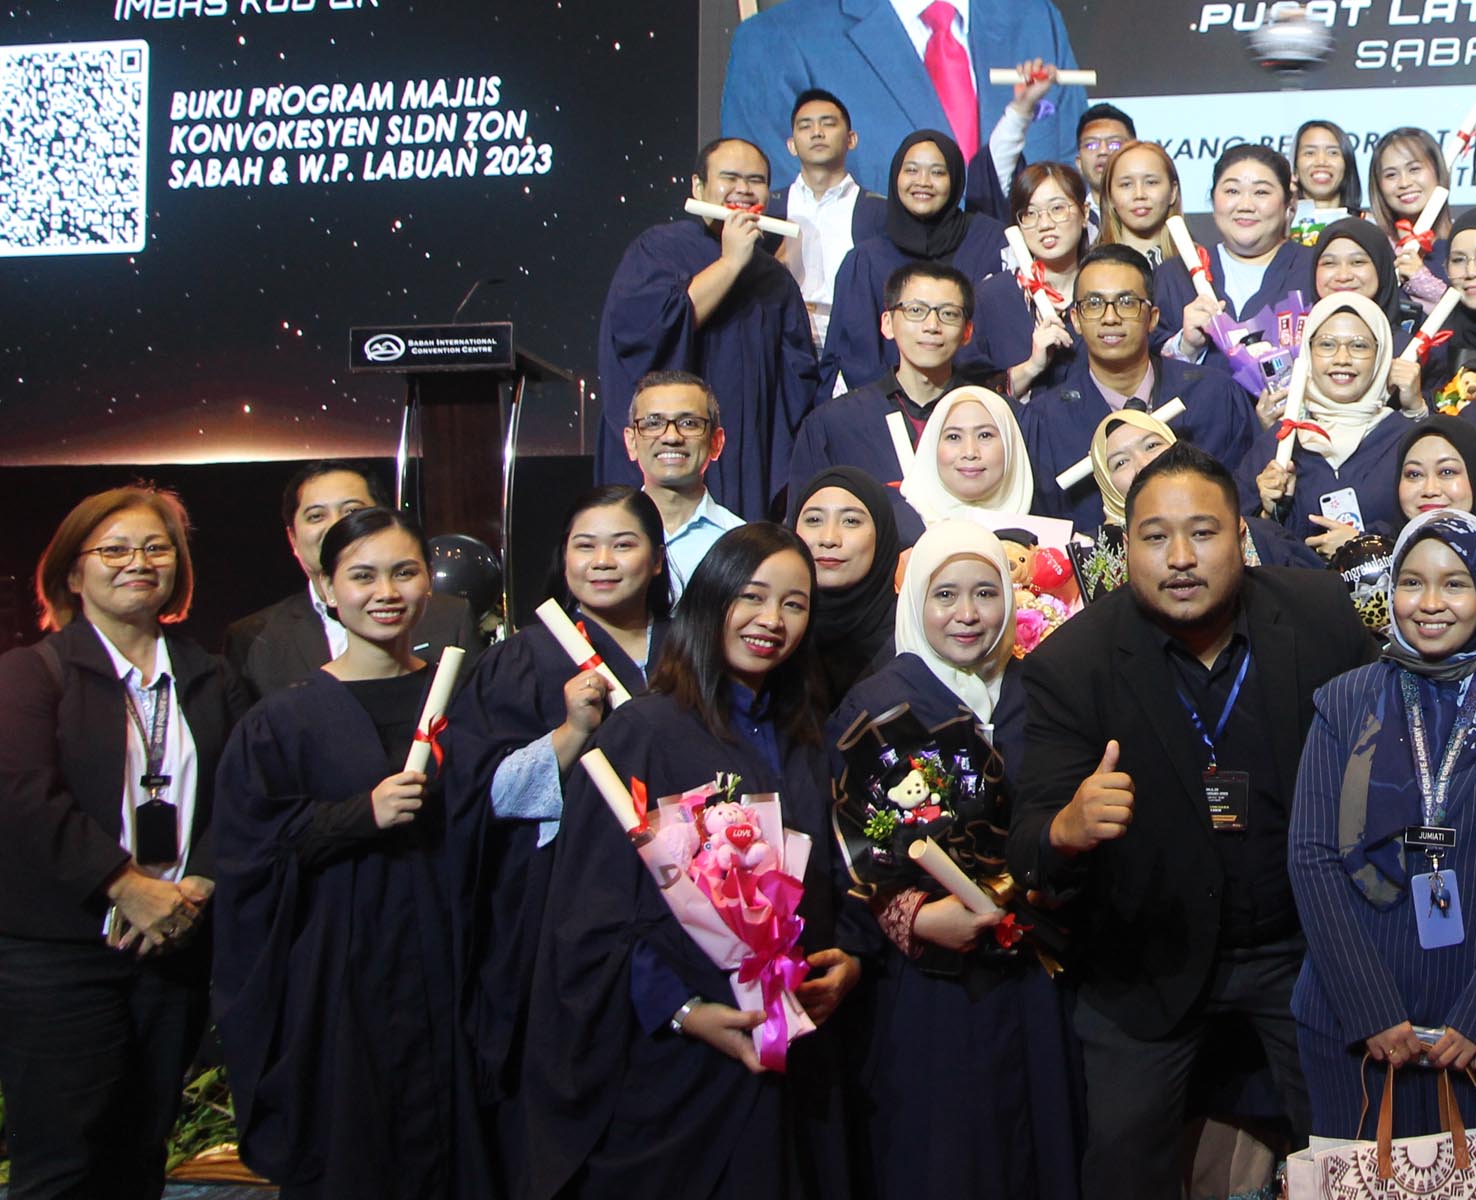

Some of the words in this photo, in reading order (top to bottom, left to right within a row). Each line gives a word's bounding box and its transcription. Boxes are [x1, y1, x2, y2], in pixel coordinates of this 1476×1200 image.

[114, 0, 228, 21] IMBAS
[170, 88, 243, 120] BUKU
[248, 81, 394, 117] PROGRAM
[400, 76, 502, 110] MAJLIS
[169, 115, 380, 154] KONVOKESYEN
[385, 112, 458, 146] SLDN
[463, 109, 528, 142] ZON
[168, 156, 265, 190] SABAH
[268, 156, 289, 185] &
[299, 152, 355, 184] W.P.
[362, 147, 479, 181] LABUAN
[483, 143, 553, 177] 2023
[411, 346, 461, 355] CONVENTION
[436, 338, 497, 346] INTERNATIONAL
[1414, 727, 1426, 762] ACADEMY
[732, 828, 752, 838] LOVE
[1418, 831, 1445, 842] JUMIATI
